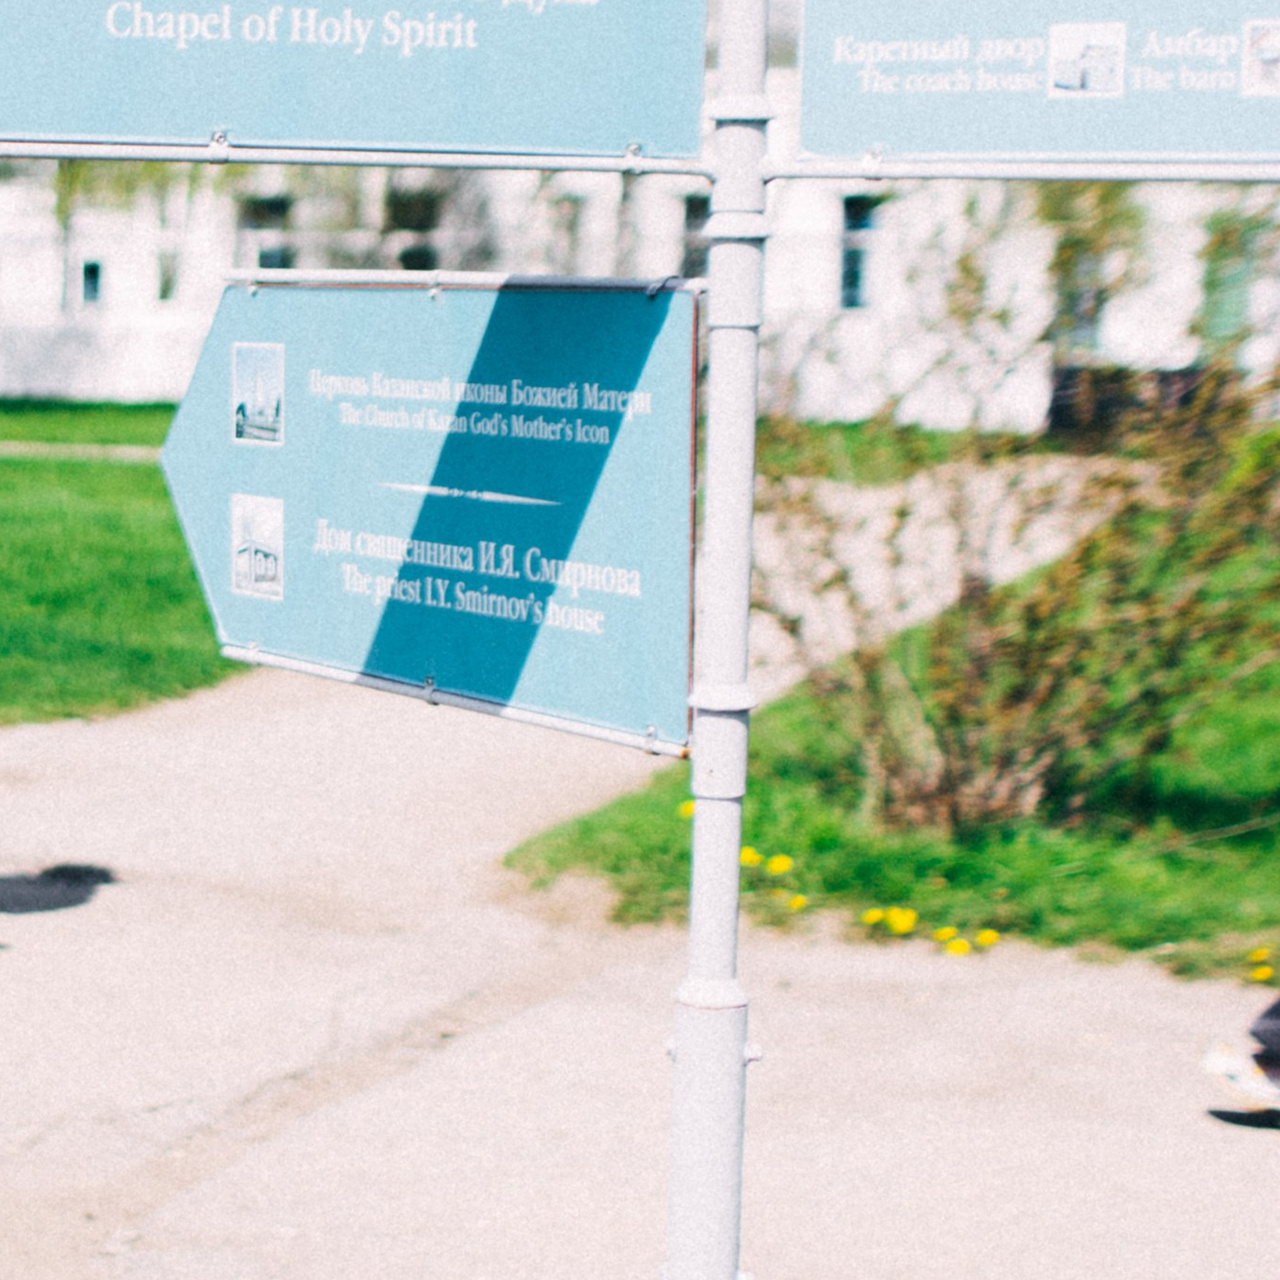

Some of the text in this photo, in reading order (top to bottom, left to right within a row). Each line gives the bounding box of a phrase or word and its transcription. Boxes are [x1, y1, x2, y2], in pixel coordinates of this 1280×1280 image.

[104, 0, 477, 58] Chapel of Holy Spirit
[1141, 27, 1243, 68] Амбар
[974, 37, 1049, 70] двор
[857, 67, 900, 94] The
[975, 64, 1045, 92] house
[1128, 65, 1175, 91] The
[455, 382, 507, 404] иконы
[511, 379, 579, 410] Божией
[583, 382, 652, 421] Матери
[340, 402, 362, 426] The
[412, 407, 426, 429] of
[427, 409, 468, 433] Kazan
[575, 419, 610, 443] Icon
[314, 518, 352, 556] Дом
[355, 530, 474, 572] священника
[524, 547, 641, 596] Смирнова
[341, 562, 372, 595] The
[373, 571, 422, 606] priest
[544, 593, 605, 633] house
